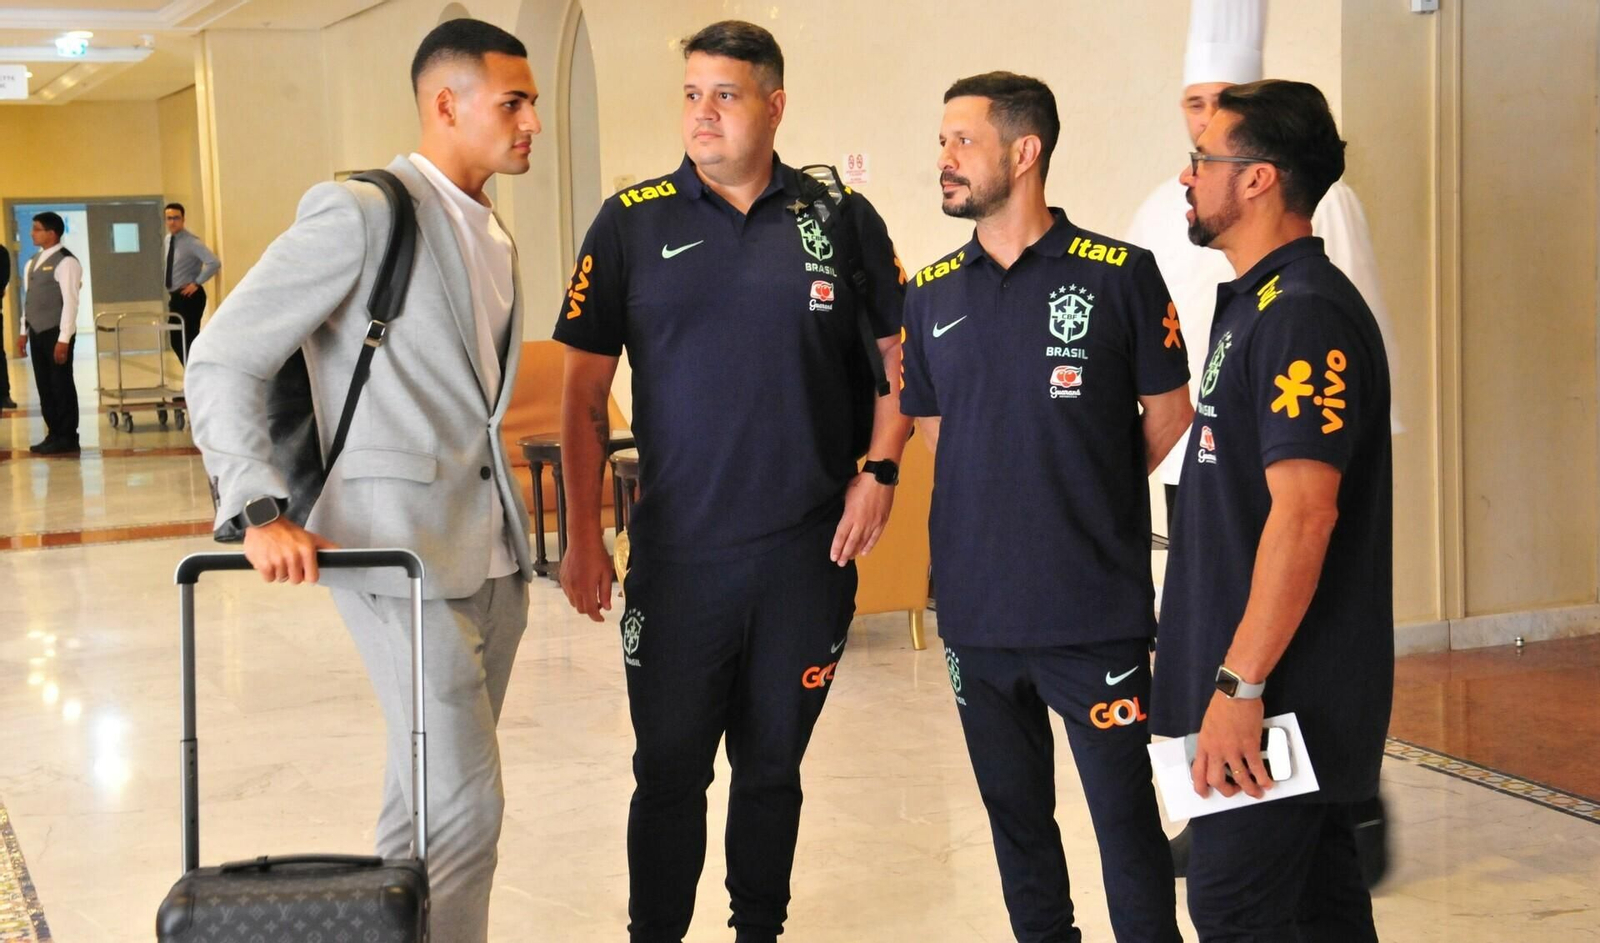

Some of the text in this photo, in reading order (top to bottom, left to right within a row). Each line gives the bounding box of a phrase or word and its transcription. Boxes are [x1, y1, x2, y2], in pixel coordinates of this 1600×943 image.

[619, 180, 677, 208] Itaú
[1067, 236, 1129, 268] Itaú
[805, 262, 838, 278] BRASIL
[566, 254, 593, 320] vivo
[1061, 313, 1078, 321] CBF
[1046, 346, 1089, 360] BRASIL
[1313, 349, 1347, 435] vivo
[1089, 696, 1147, 730] GOL
